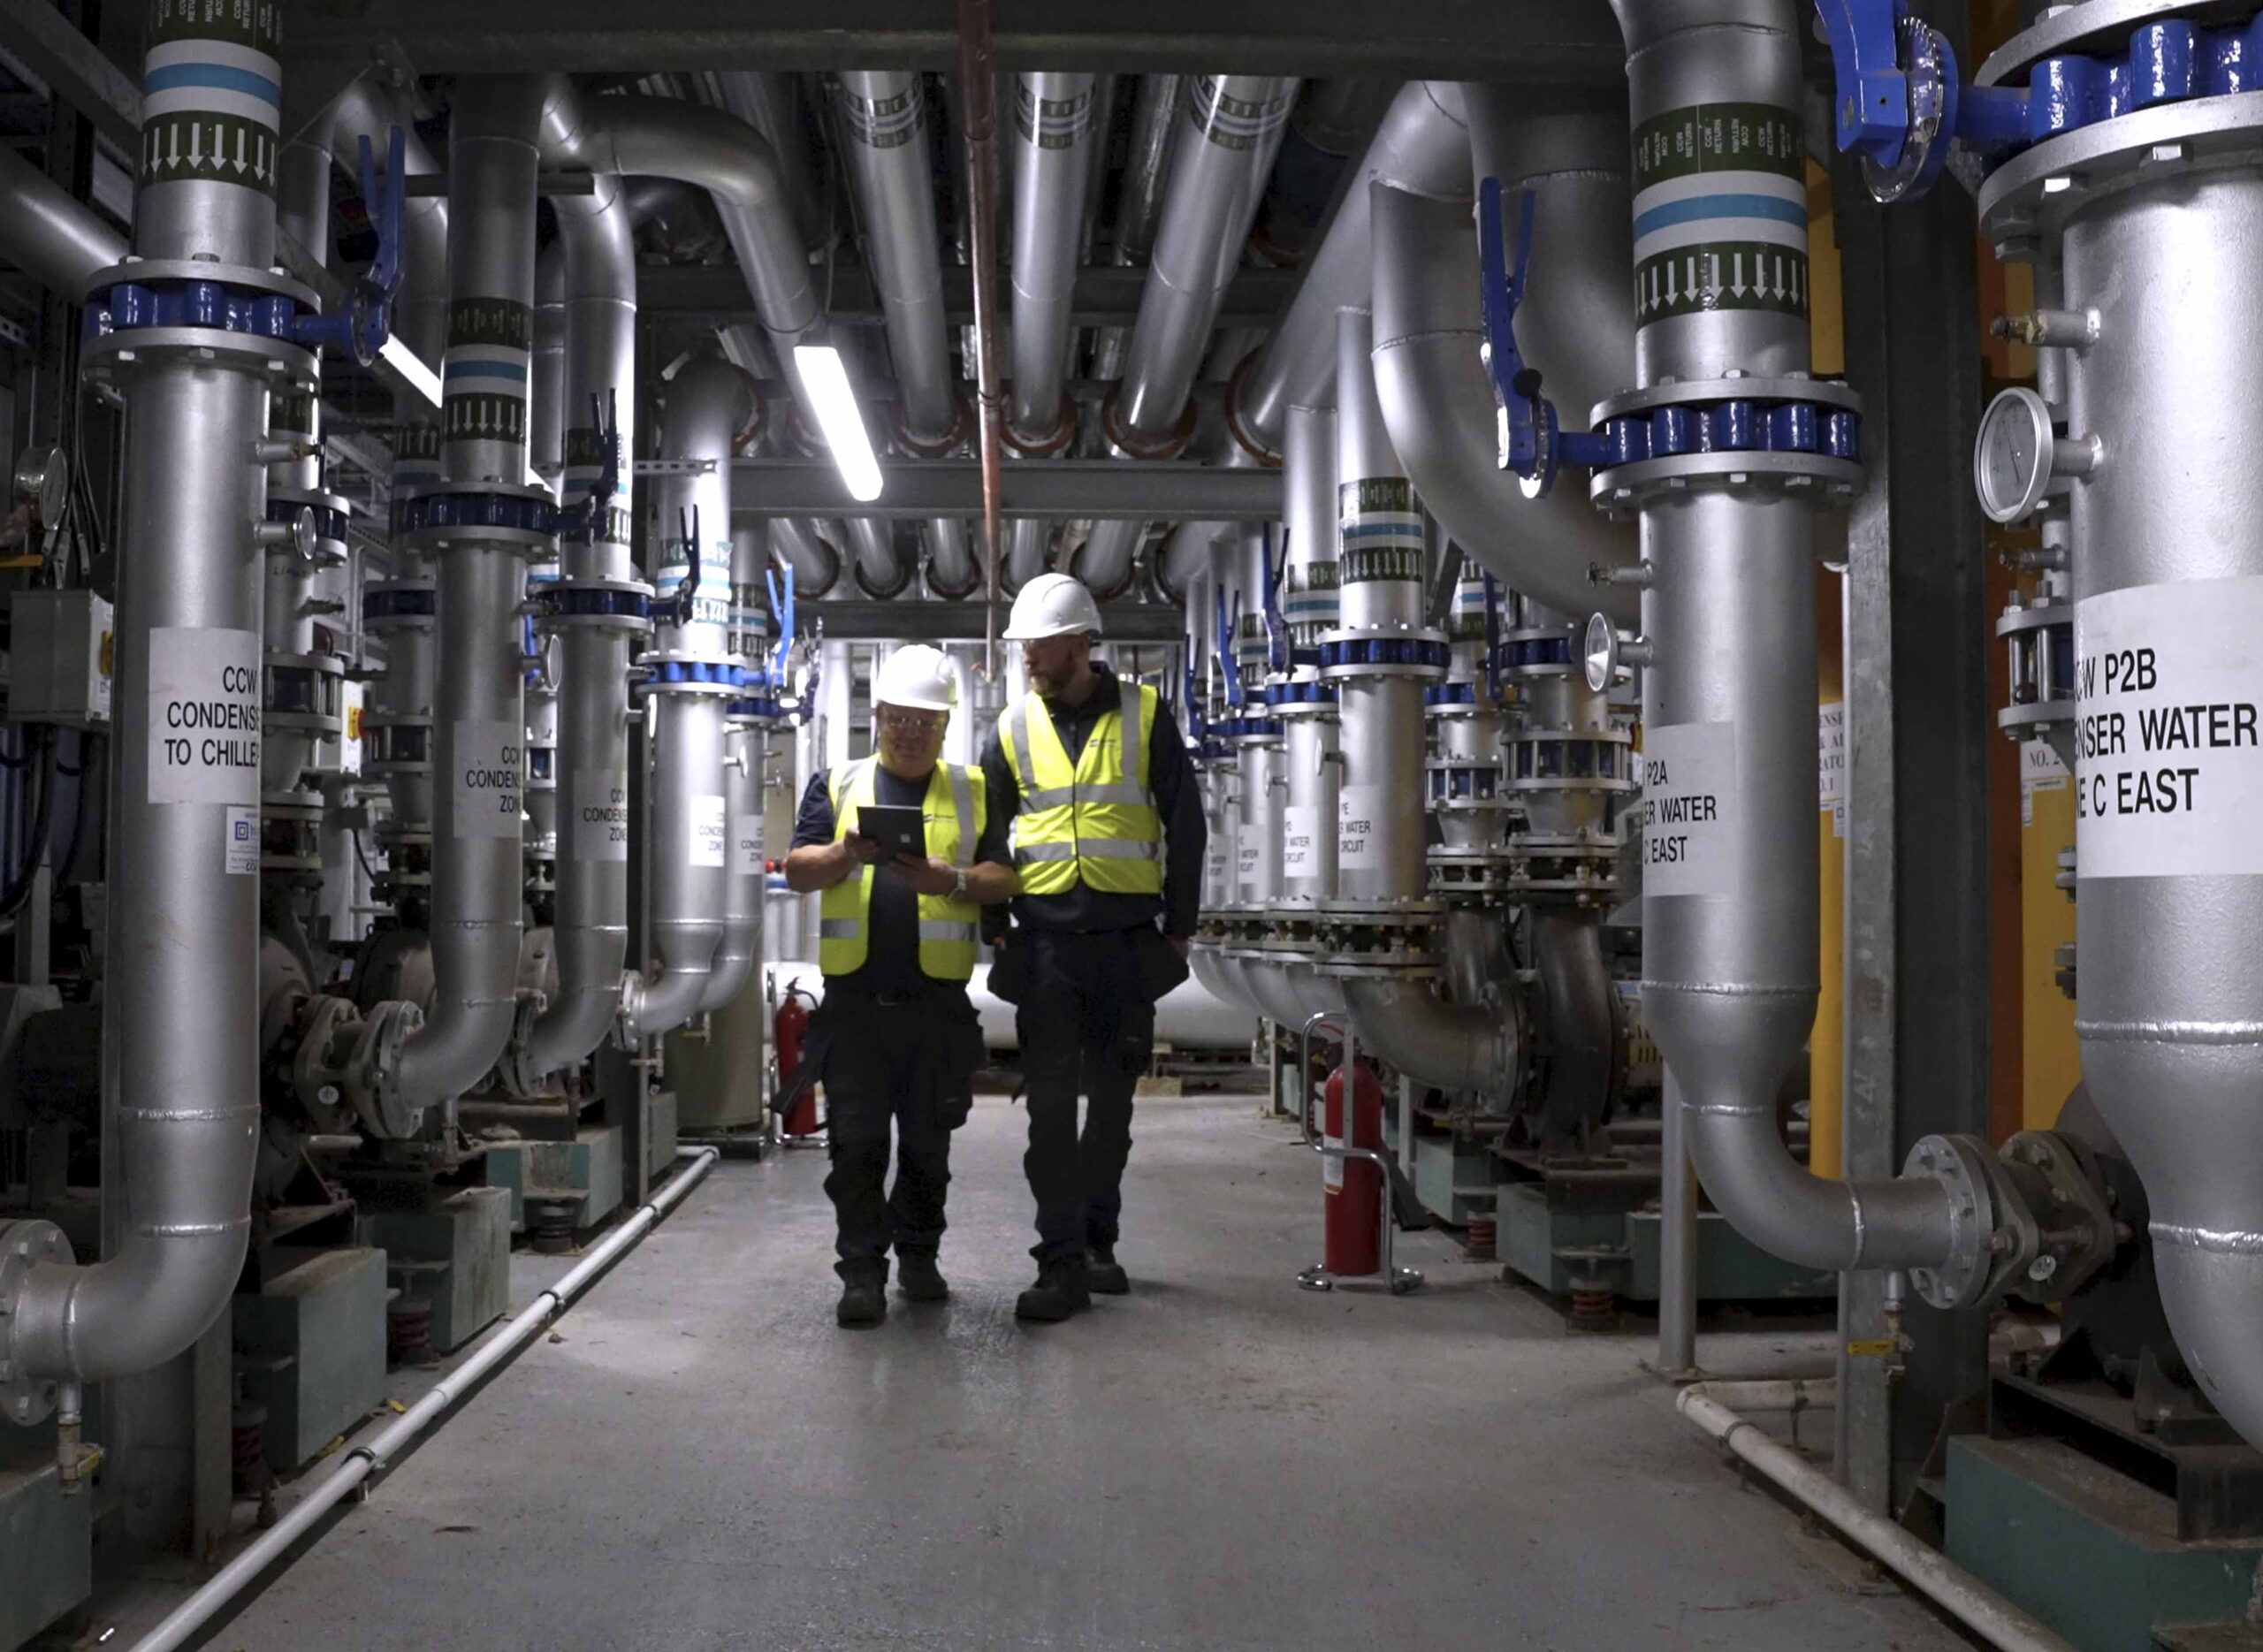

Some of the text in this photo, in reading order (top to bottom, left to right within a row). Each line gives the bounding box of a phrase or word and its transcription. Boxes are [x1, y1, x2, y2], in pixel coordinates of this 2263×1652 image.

[223, 666, 257, 694] CCW
[2105, 648, 2157, 695] P2B
[2138, 704, 2259, 751] WATER
[164, 739, 192, 765] TO
[1647, 760, 1668, 786] P2A
[2093, 773, 2107, 817] C
[2117, 768, 2199, 815] EAST
[1660, 796, 1717, 824] WATER
[1652, 836, 1688, 864] EAST
